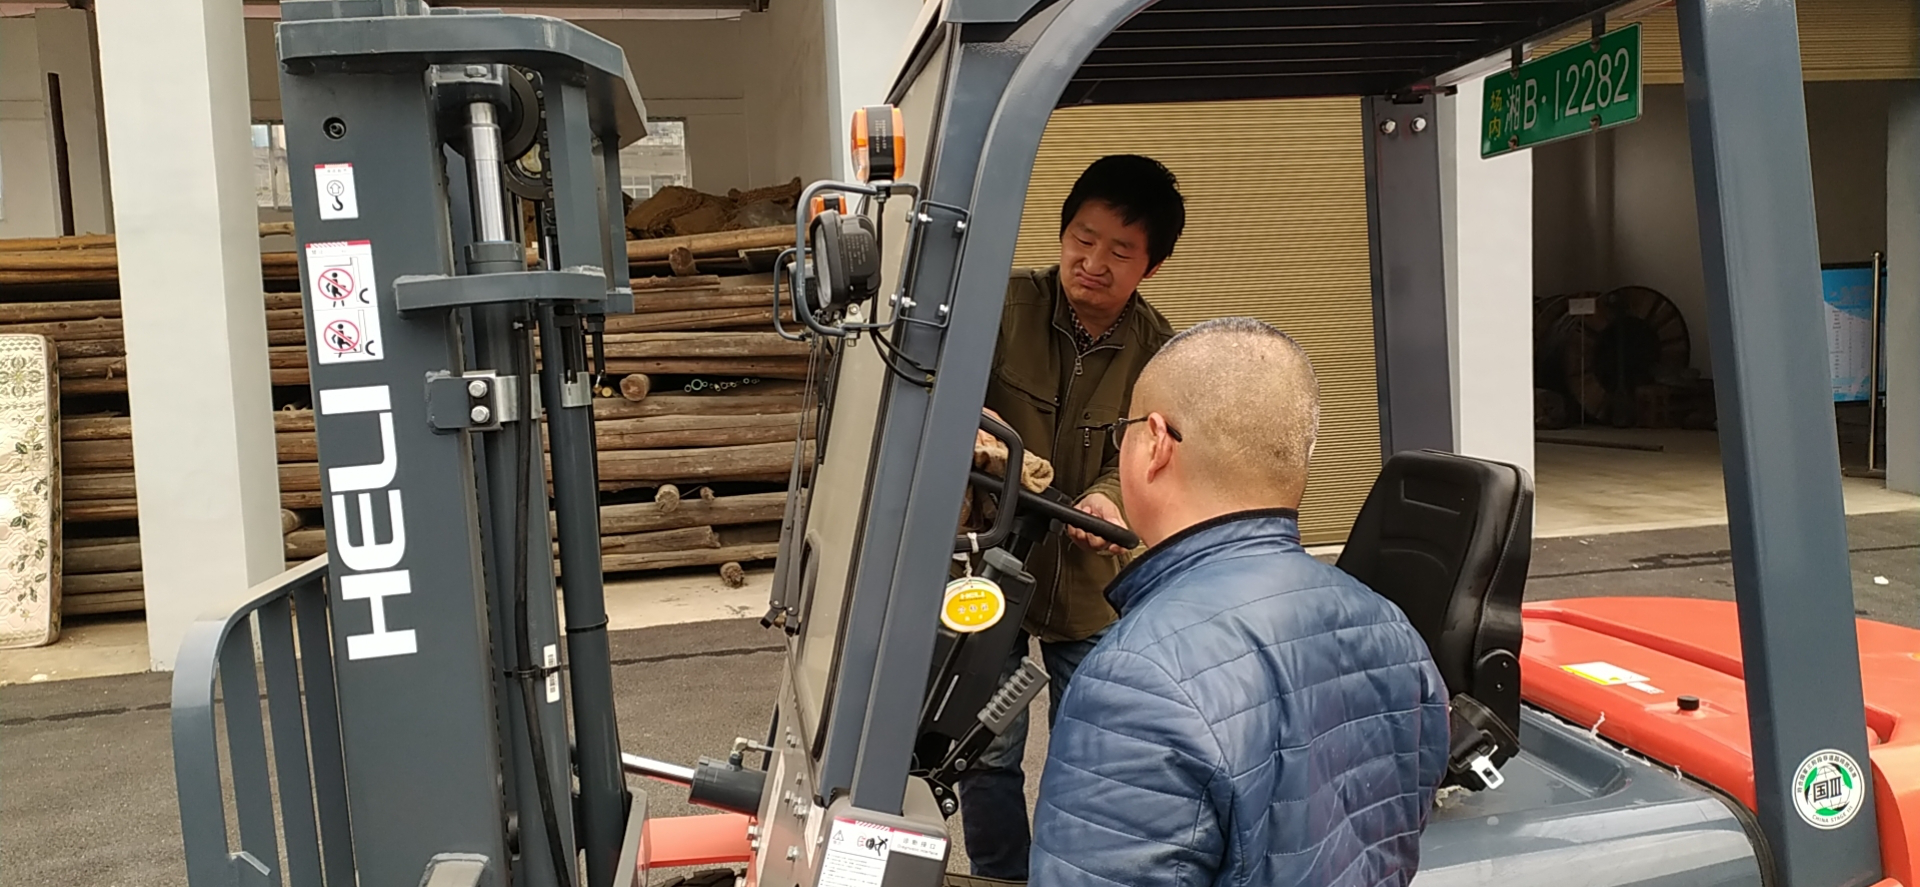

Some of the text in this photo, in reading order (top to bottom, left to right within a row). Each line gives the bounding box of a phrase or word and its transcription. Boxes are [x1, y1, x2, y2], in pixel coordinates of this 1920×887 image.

[1488, 89, 1503, 138] 场内
[319, 385, 418, 660] HELI
[1812, 814, 1829, 823] CHINA
[1831, 812, 1847, 823] STAGE
